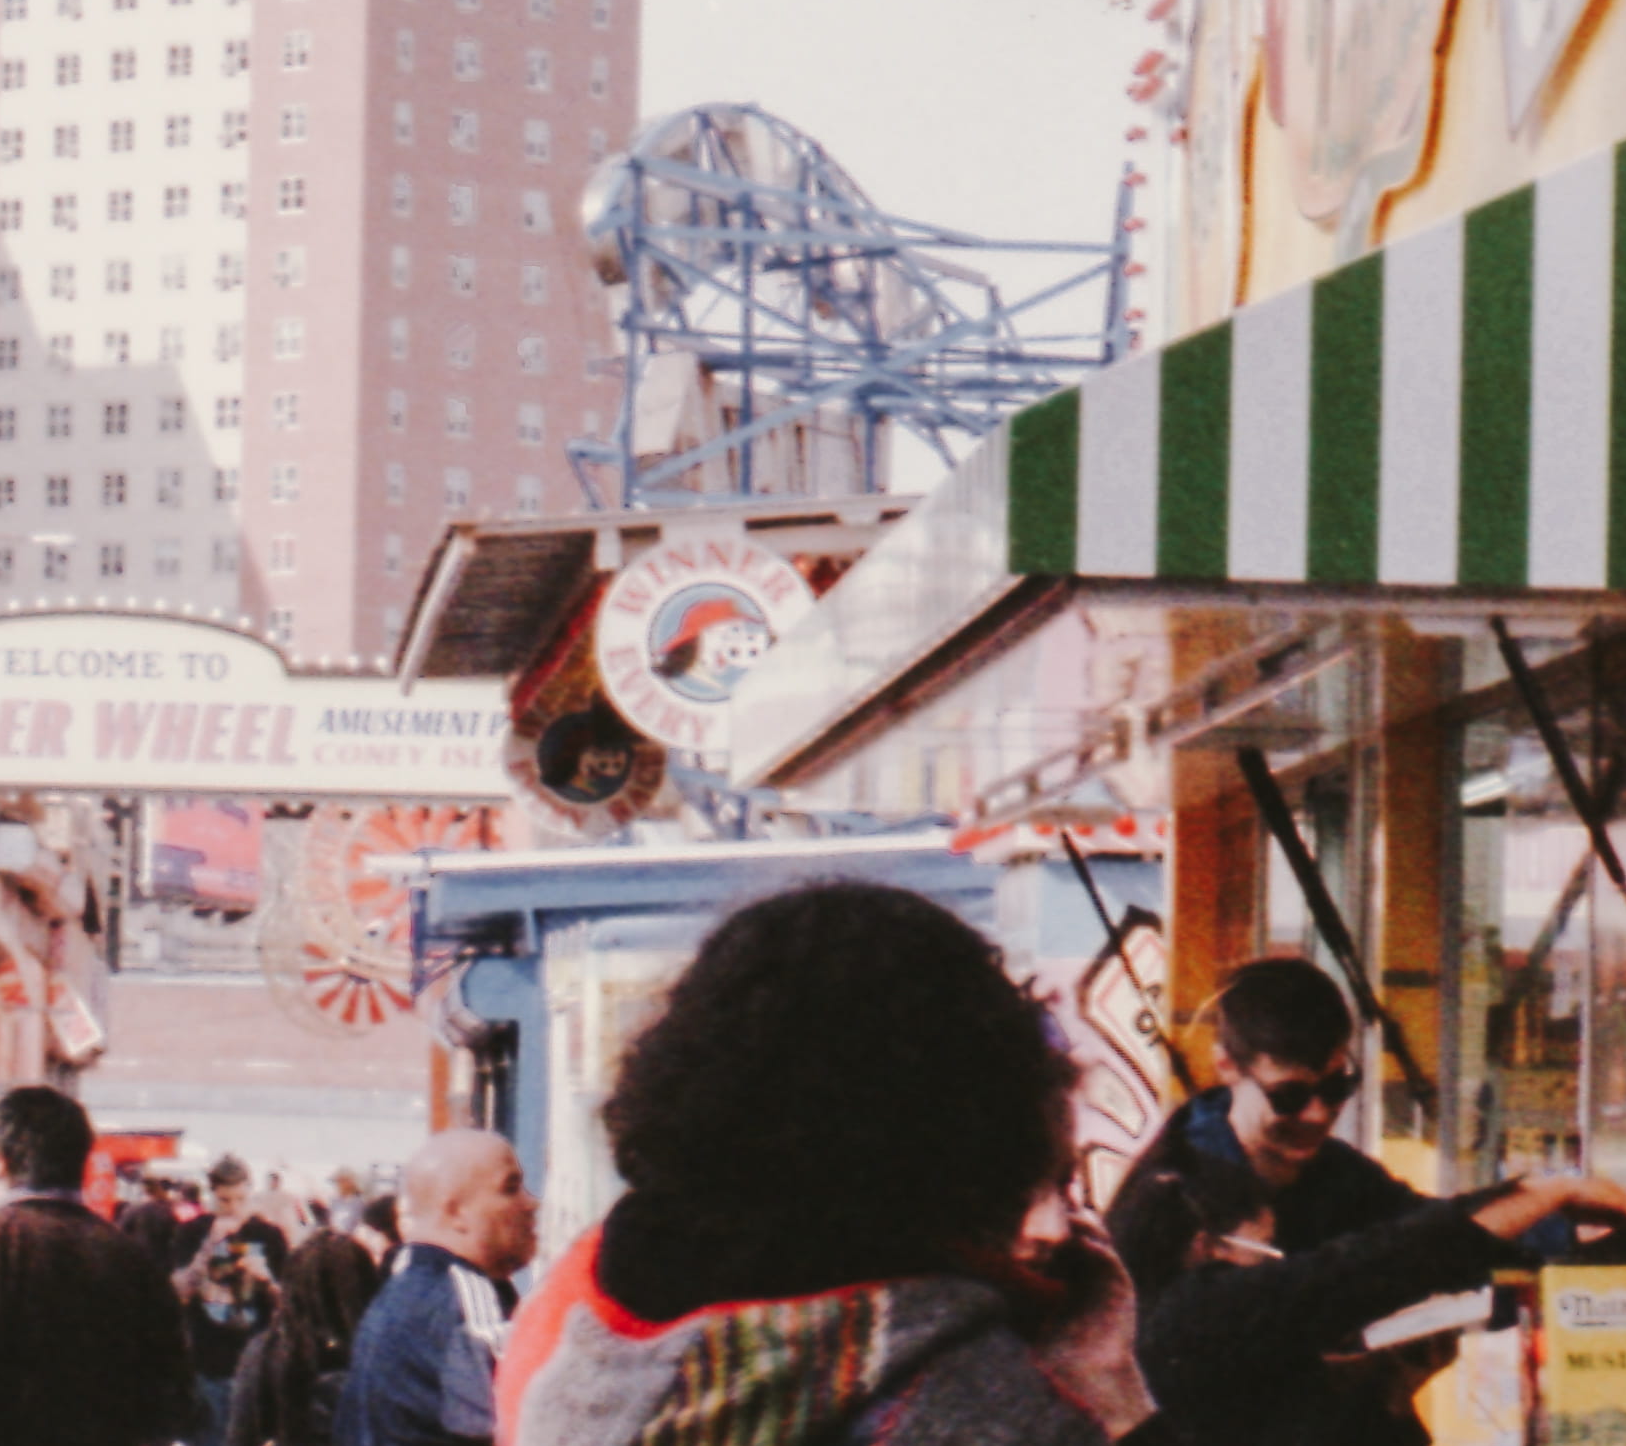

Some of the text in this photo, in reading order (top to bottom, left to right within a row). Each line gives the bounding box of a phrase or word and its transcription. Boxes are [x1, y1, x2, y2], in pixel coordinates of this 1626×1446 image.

[614, 540, 798, 616] WINNER
[179, 651, 230, 682] TO
[94, 700, 297, 767] WHEEL
[316, 706, 483, 738] AMUSEMENT
[312, 744, 426, 768] CONEY
